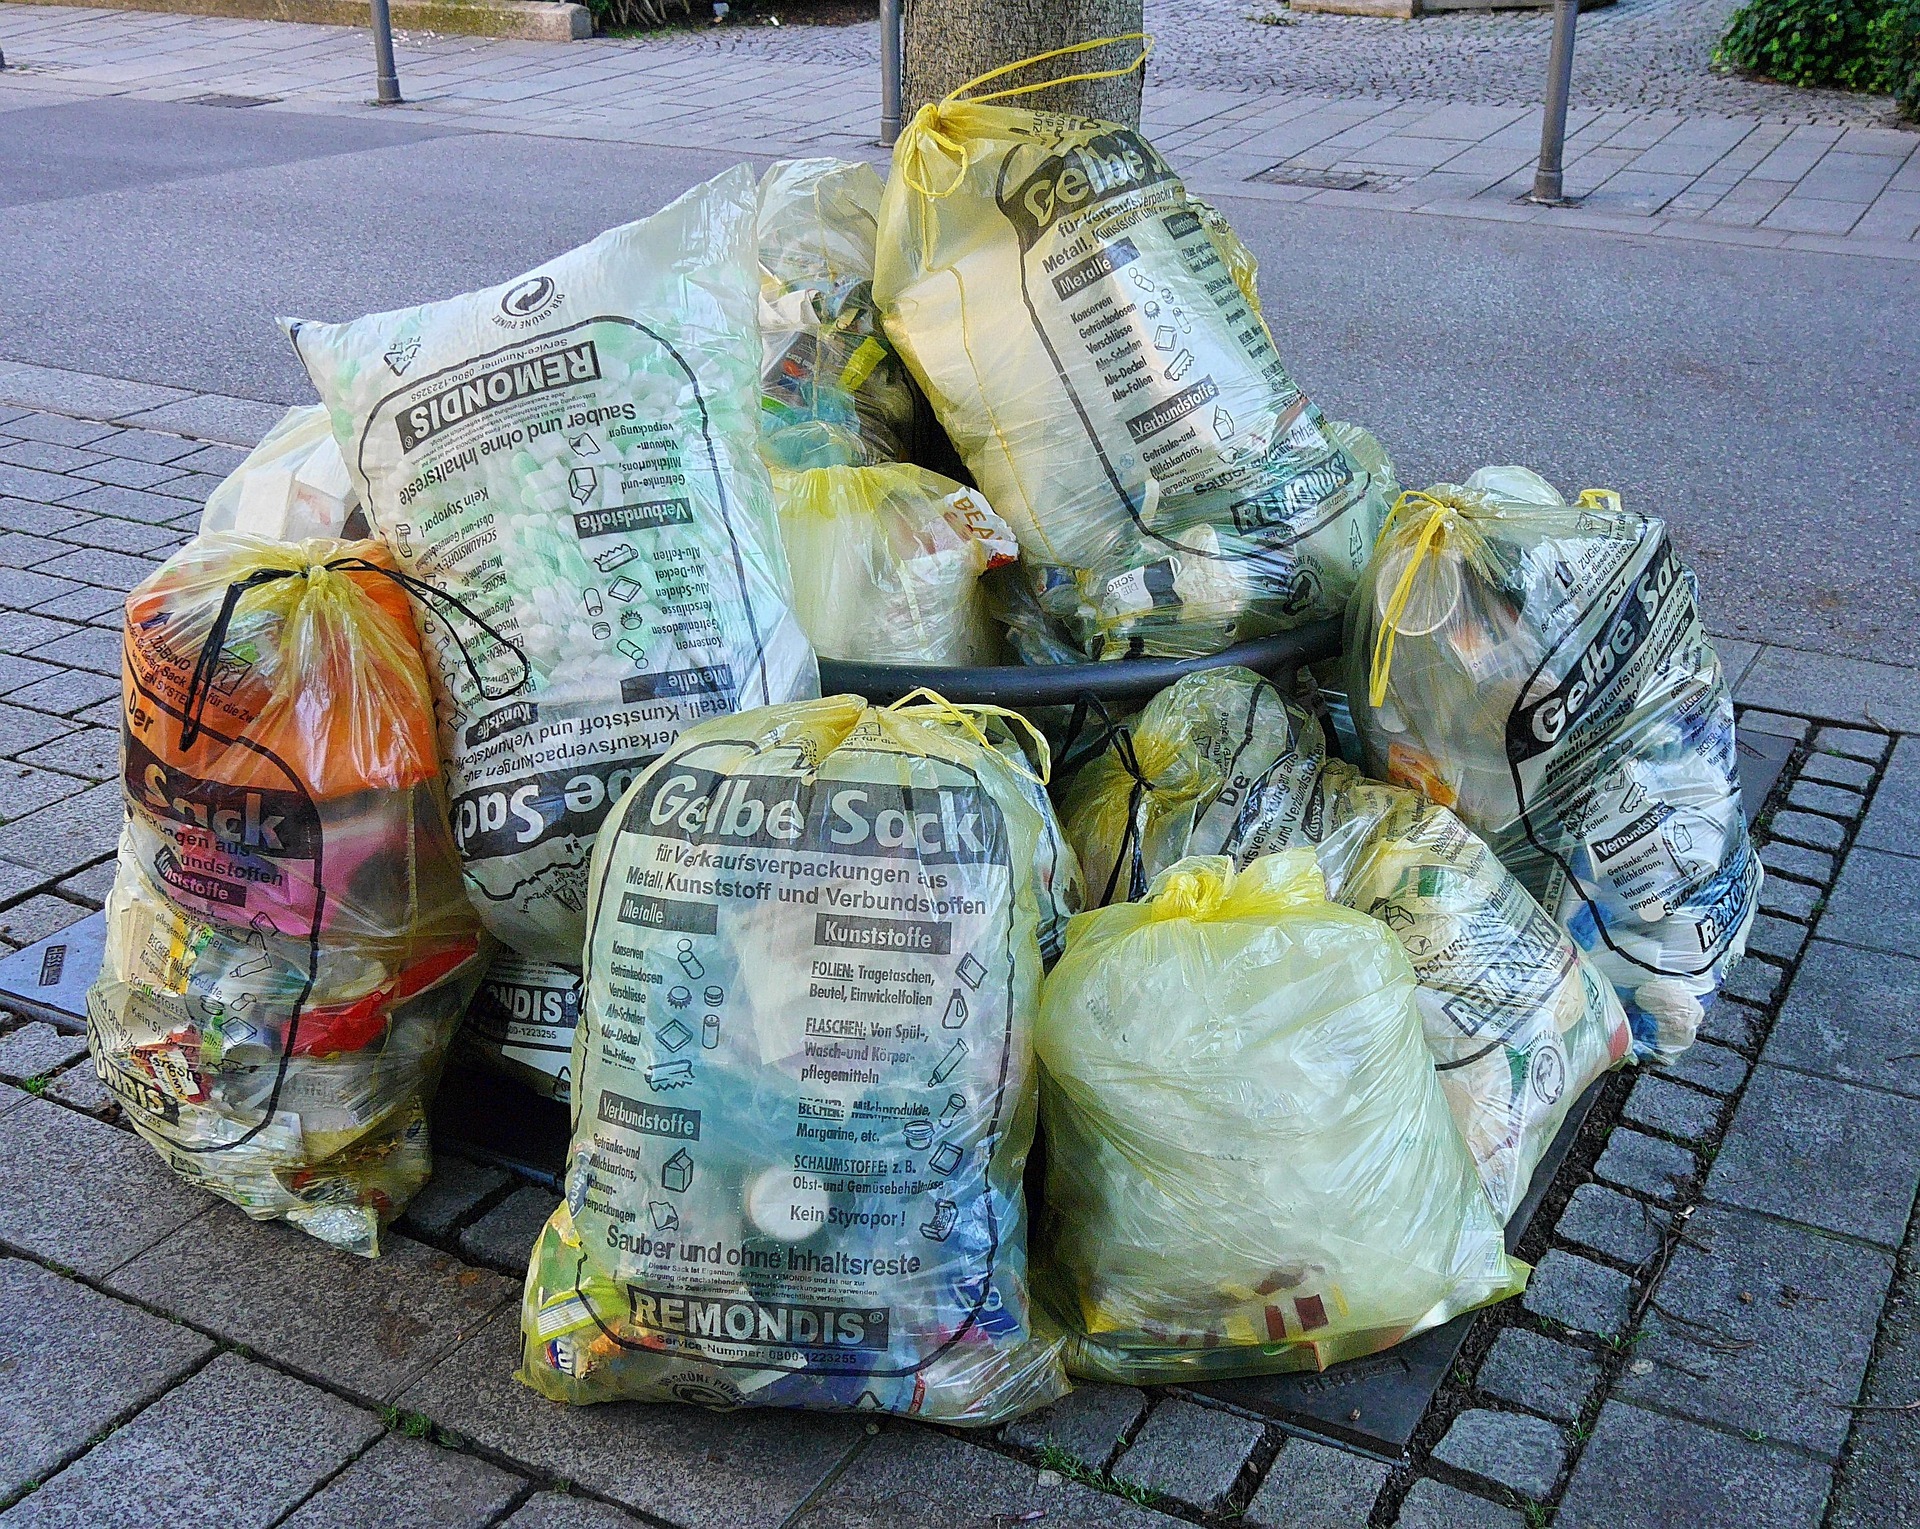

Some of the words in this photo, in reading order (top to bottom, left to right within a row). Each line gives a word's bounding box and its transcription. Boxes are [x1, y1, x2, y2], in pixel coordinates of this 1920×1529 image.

[1024, 145, 1146, 227] Gelbe
[1057, 219, 1081, 238] für
[1042, 236, 1093, 274] Metall,
[1059, 257, 1113, 294] Metalle
[492, 314, 517, 330] PUNKT
[519, 309, 552, 330] GRÜNE
[1070, 296, 1113, 325] Konserven
[1078, 302, 1137, 339] Getränkedosen
[1085, 323, 1133, 354] Verschlüsse
[1095, 338, 1143, 372] Alu-Schalen
[410, 368, 475, 402] 0800-1223255
[1103, 355, 1148, 388] Alu-Deckel
[409, 345, 592, 440] REMONDIS
[1111, 374, 1154, 403] Alu-Folien
[567, 402, 637, 428] Sauber
[1131, 383, 1216, 435] Verbundstoffe
[481, 428, 524, 456] ohne
[527, 418, 563, 438] und
[608, 423, 674, 438] verpackungen
[636, 439, 679, 450] Vakuum-
[1142, 427, 1197, 462] Getränke-und
[618, 456, 682, 472] Milchkartons,
[1149, 446, 1203, 478] Milchkartons,
[399, 453, 480, 506] Inhaltsreste
[620, 473, 686, 494] Getränke-und
[465, 487, 490, 507] Kein
[1236, 457, 1347, 532] REMONDIS
[427, 499, 464, 533] Styropor
[579, 501, 688, 532] Verbundstoffe
[952, 496, 1003, 541] BEA
[653, 546, 701, 561] Alu-Folien
[655, 564, 706, 583] Alu-Deckel
[655, 581, 711, 597] Alu-Schalen
[661, 600, 716, 618] Verschlüsse
[651, 618, 720, 636] Getränkedosen
[676, 636, 725, 651] Konserven
[668, 667, 729, 693] Metalle
[1531, 618, 1636, 742] Gelbe
[129, 687, 154, 734] Der
[206, 692, 221, 709] für
[223, 702, 239, 717] die
[579, 704, 680, 730] Kunststoff
[682, 698, 743, 719] Metall,
[539, 722, 574, 739] und
[1567, 726, 1585, 745] für
[144, 763, 285, 850] Sack
[650, 774, 805, 840] Gelbe
[831, 789, 987, 855] Sack
[180, 854, 283, 886] undstoffen
[655, 843, 672, 862] für
[675, 846, 910, 887] Verkaufsverpackungen
[1607, 843, 1658, 876] Getränke-und
[1612, 857, 1665, 889] Milchkartons,
[156, 850, 229, 900] Kunststoffe
[626, 866, 664, 893] Metall,
[665, 871, 772, 900] Kunststoff
[778, 886, 819, 905] und
[825, 887, 986, 915] Verbundstoffen
[1620, 880, 1655, 900] Vakuum-
[1629, 883, 1678, 911] verpackungen
[621, 899, 664, 923] Metalle
[824, 920, 933, 948] Kunststoffe
[612, 940, 644, 961] Konserven
[610, 962, 663, 985] Getränkedosen
[811, 960, 854, 979] FOLIEN:
[858, 965, 936, 986] Tragetaschen,
[608, 982, 647, 1004] Verschlüsse
[809, 984, 848, 1003] Beutel,
[850, 986, 933, 1007] Einwickelfolien
[805, 1017, 867, 1038] FLASCHEN:
[870, 1021, 892, 1038] Von
[895, 1023, 930, 1043] Spül-,
[804, 1042, 868, 1061] Wasch-und
[871, 1045, 916, 1066] Körper-
[801, 1064, 879, 1084] pflegemitteln
[602, 1097, 695, 1136] Verbundstoffe
[593, 1133, 641, 1161] Getränke-und
[796, 1123, 858, 1144] Margarine,
[861, 1130, 880, 1143] etc.
[793, 1154, 888, 1175] SCHAUMSTOFFE:
[793, 1176, 844, 1193] Obst-und
[790, 1205, 825, 1223] Kein
[827, 1207, 898, 1229] Styropor
[606, 1224, 676, 1261] Sauber
[680, 1242, 721, 1264] und
[726, 1243, 781, 1268] ohne
[787, 1248, 921, 1276] Inhaltsreste
[635, 1295, 866, 1344] REMONDIS
[656, 1334, 765, 1360] Service-Nummer:
[769, 1351, 857, 1364] 0800-1223255
